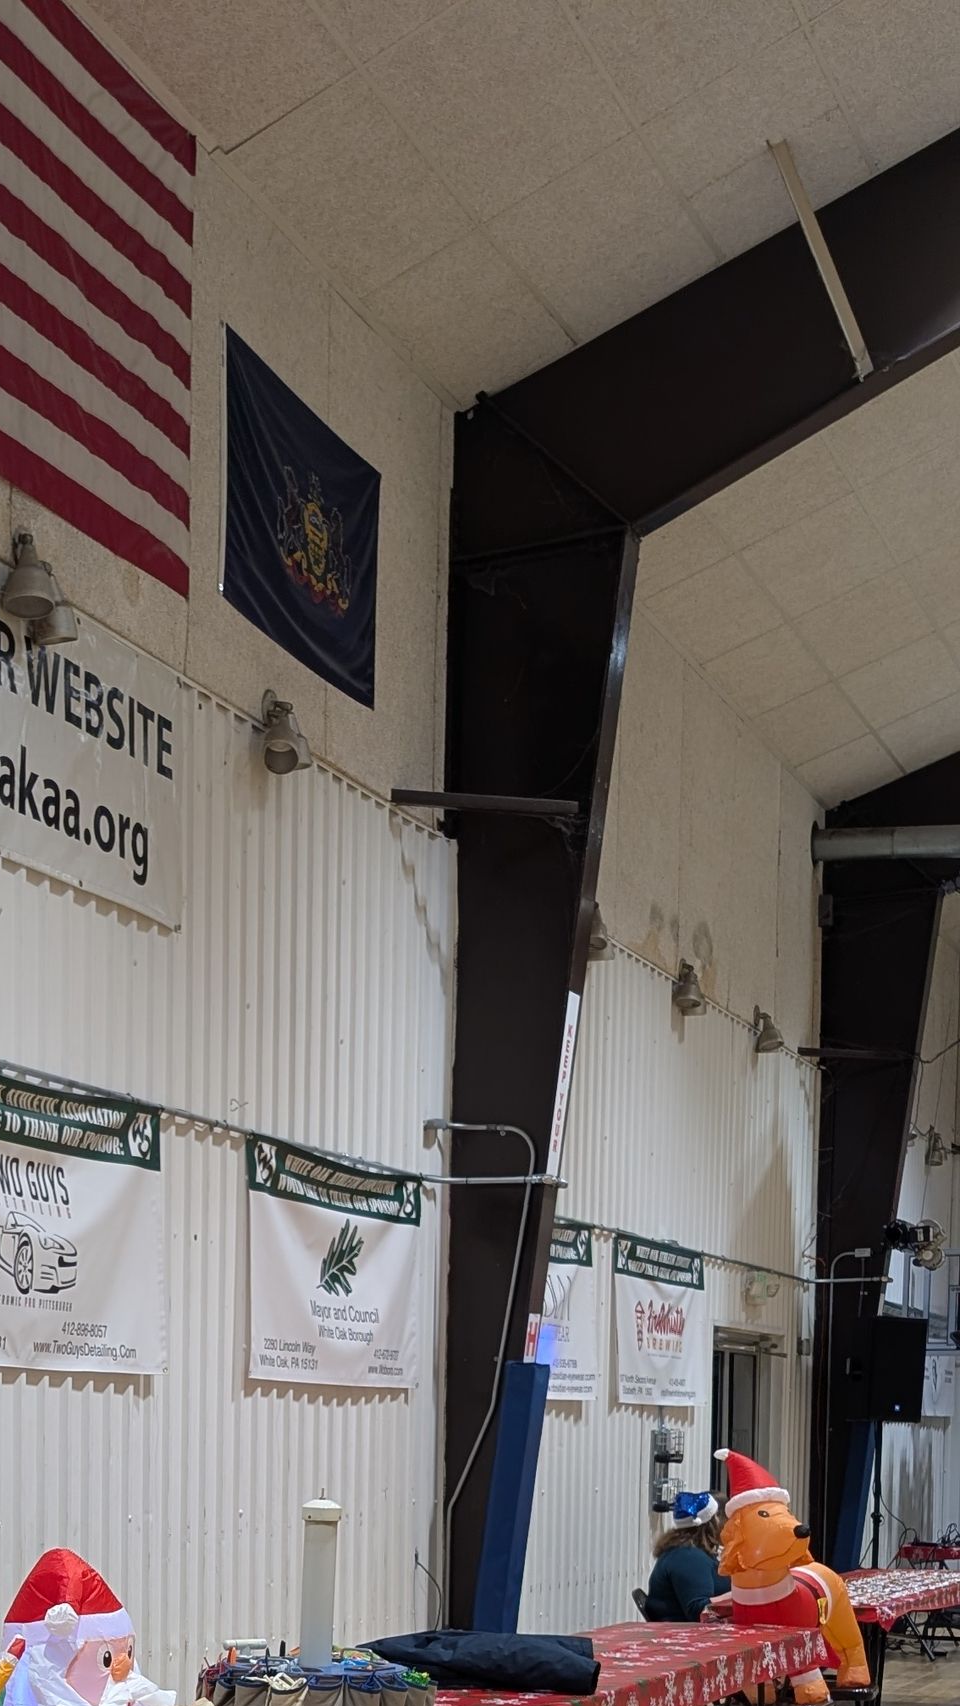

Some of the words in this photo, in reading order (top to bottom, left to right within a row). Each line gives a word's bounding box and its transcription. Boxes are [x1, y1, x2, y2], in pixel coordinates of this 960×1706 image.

[24, 632, 174, 781] WEBSITE
[551, 1023, 573, 1083] KEEP
[6, 1088, 59, 1117] ATHLETIC
[59, 1100, 128, 1130] ASSOCIATION
[542, 1092, 564, 1154] YOUR
[4, 1111, 21, 1134] TO
[22, 1116, 60, 1143] THANK
[61, 1126, 82, 1147] OUR
[25, 1160, 70, 1206] GUYS
[310, 1300, 332, 1322] Mayor
[333, 1306, 347, 1321] and
[348, 1305, 380, 1324] Council
[279, 1339, 301, 1353] Lincoln
[302, 1341, 317, 1357] Way
[318, 1324, 335, 1339] White
[335, 1326, 348, 1340] Oak
[348, 1328, 374, 1346] Borough
[259, 1354, 276, 1370] White
[291, 1357, 300, 1369] PA
